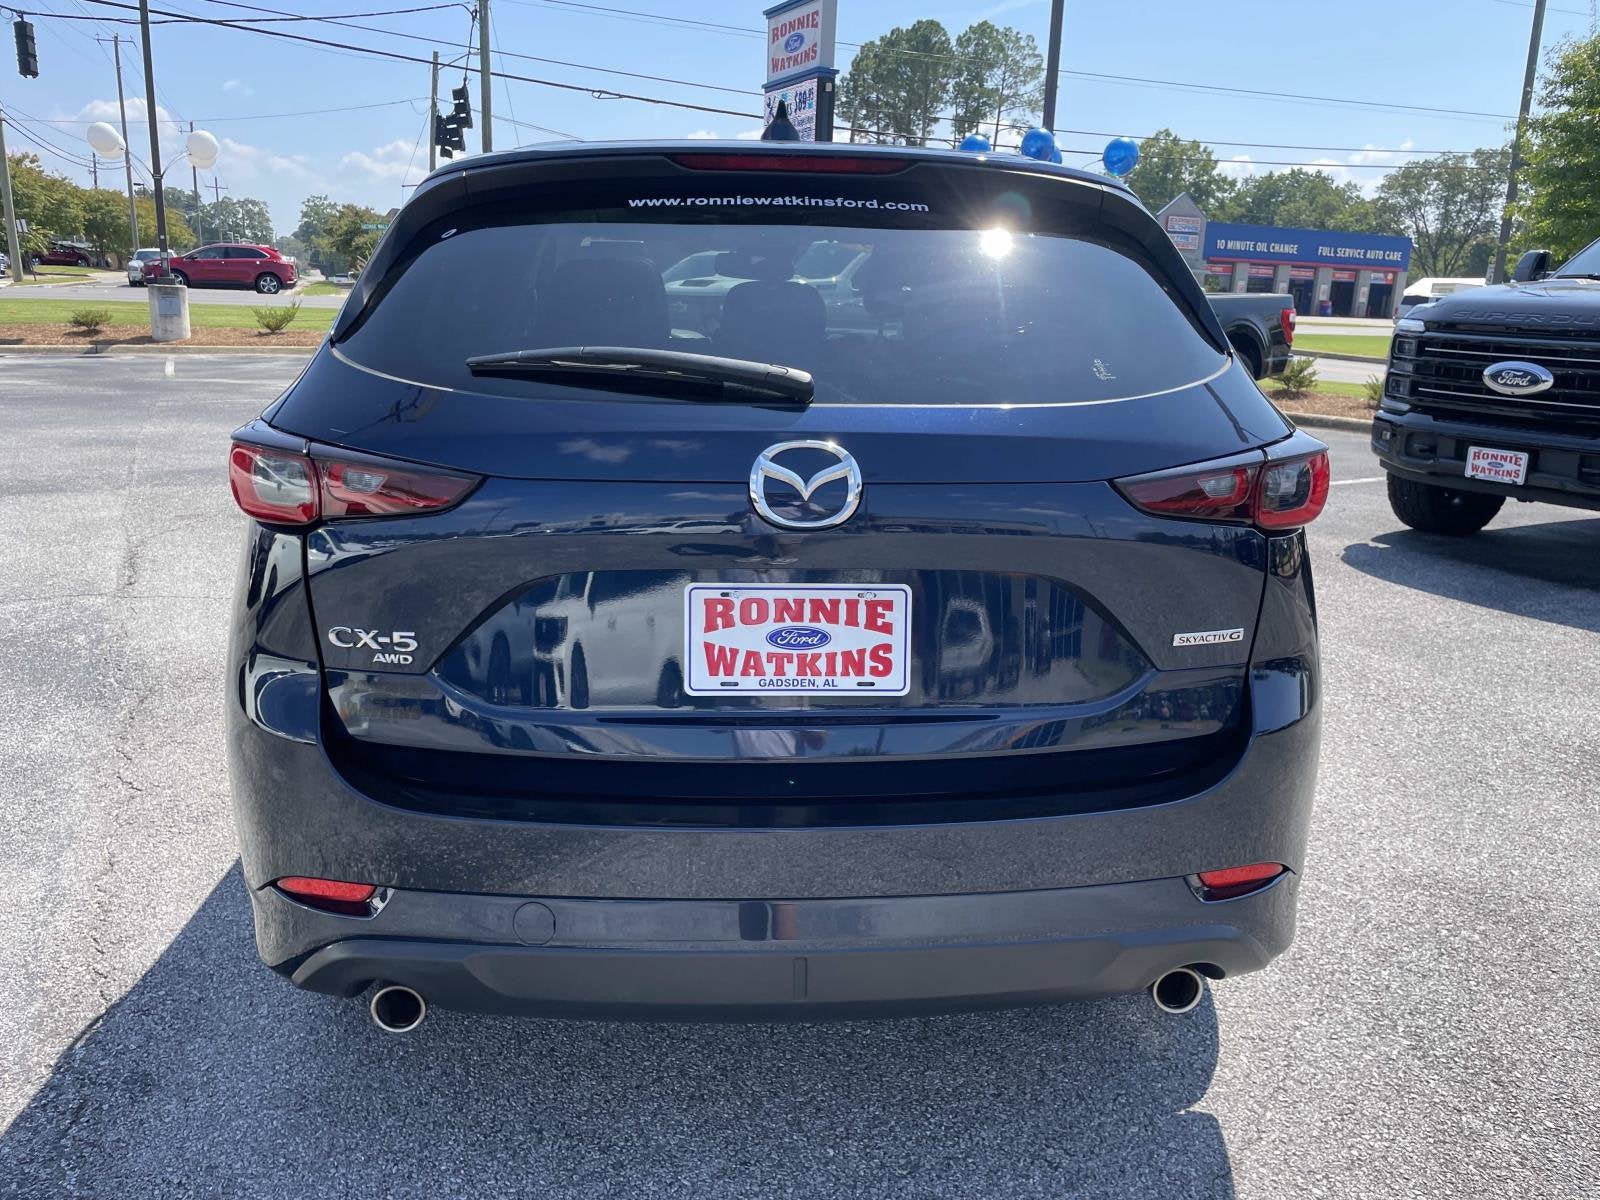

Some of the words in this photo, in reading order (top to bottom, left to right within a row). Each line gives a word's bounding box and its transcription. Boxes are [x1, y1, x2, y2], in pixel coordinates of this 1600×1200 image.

[772, 10, 819, 44] RONNIE
[771, 42, 818, 73] WATKINS
[628, 195, 929, 212] www.ronniewatkinsford.com
[1216, 239, 1226, 249] 10
[1227, 240, 1256, 251] MINUTE
[1256, 242, 1268, 253] OIL
[1269, 243, 1298, 254] CHANGE
[1318, 246, 1335, 257] FULL
[1336, 247, 1365, 258] SERVICE
[1366, 250, 1384, 260] AUTO
[1384, 251, 1403, 261] CARE
[1451, 311, 1544, 322] SUPER
[1551, 313, 1600, 325] DU
[1497, 370, 1531, 386] Ford
[1472, 451, 1523, 468] RONNIE
[1471, 463, 1521, 479] WATKINS
[704, 598, 894, 636] RONNIE
[328, 626, 418, 652] CX-5
[777, 629, 822, 646] Ford
[372, 653, 413, 665] AWD
[703, 641, 893, 678] WATKINS
[758, 678, 819, 689] GADSDEN,
[823, 679, 838, 688] AL
